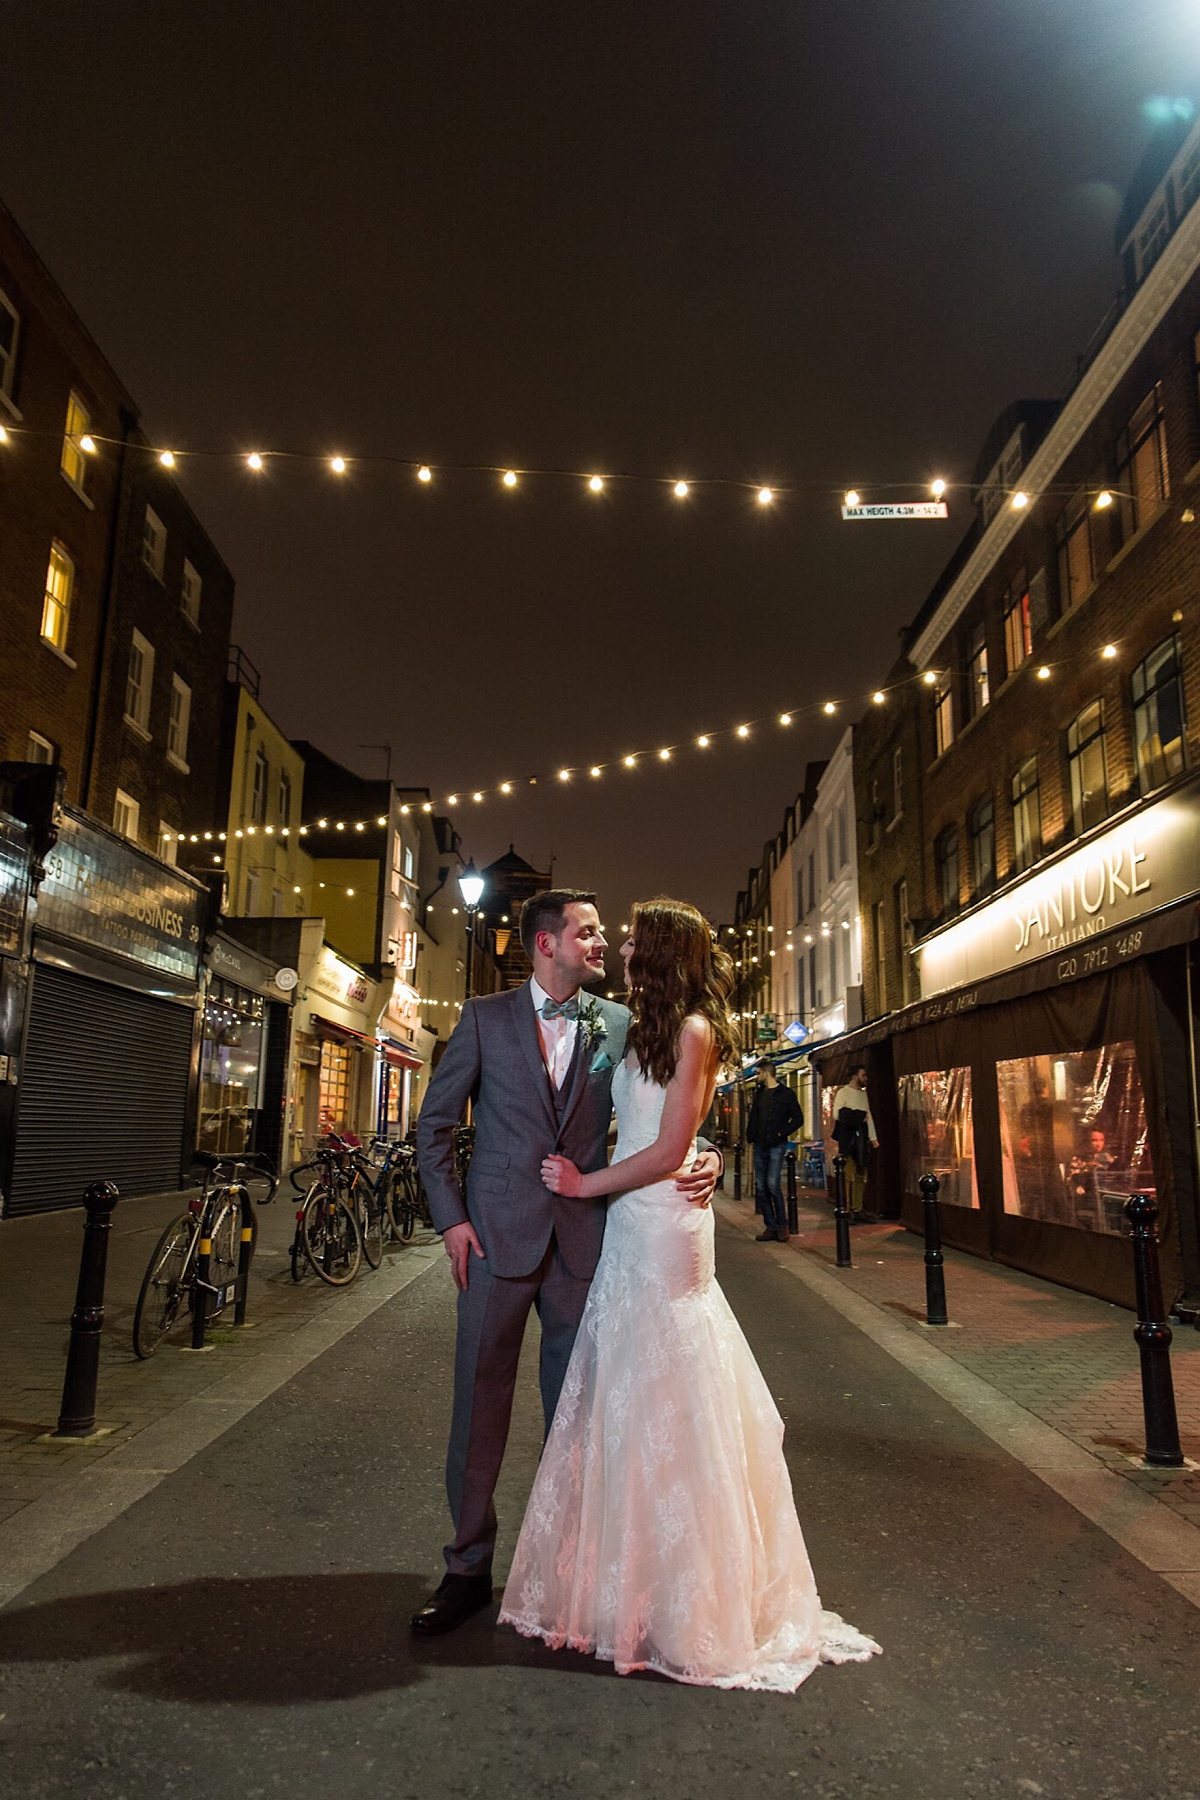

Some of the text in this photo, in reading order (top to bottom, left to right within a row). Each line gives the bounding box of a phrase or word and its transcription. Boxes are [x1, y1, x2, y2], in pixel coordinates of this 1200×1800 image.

[847, 507, 864, 516] MAX
[867, 507, 894, 516] HEIGTH
[47, 856, 63, 879] 58
[1014, 837, 1152, 952] SANTORE
[125, 889, 183, 939] BUSINESS
[101, 917, 129, 939] TATTOO
[189, 924, 200, 943] 58
[1047, 916, 1106, 952] ITALIANO
